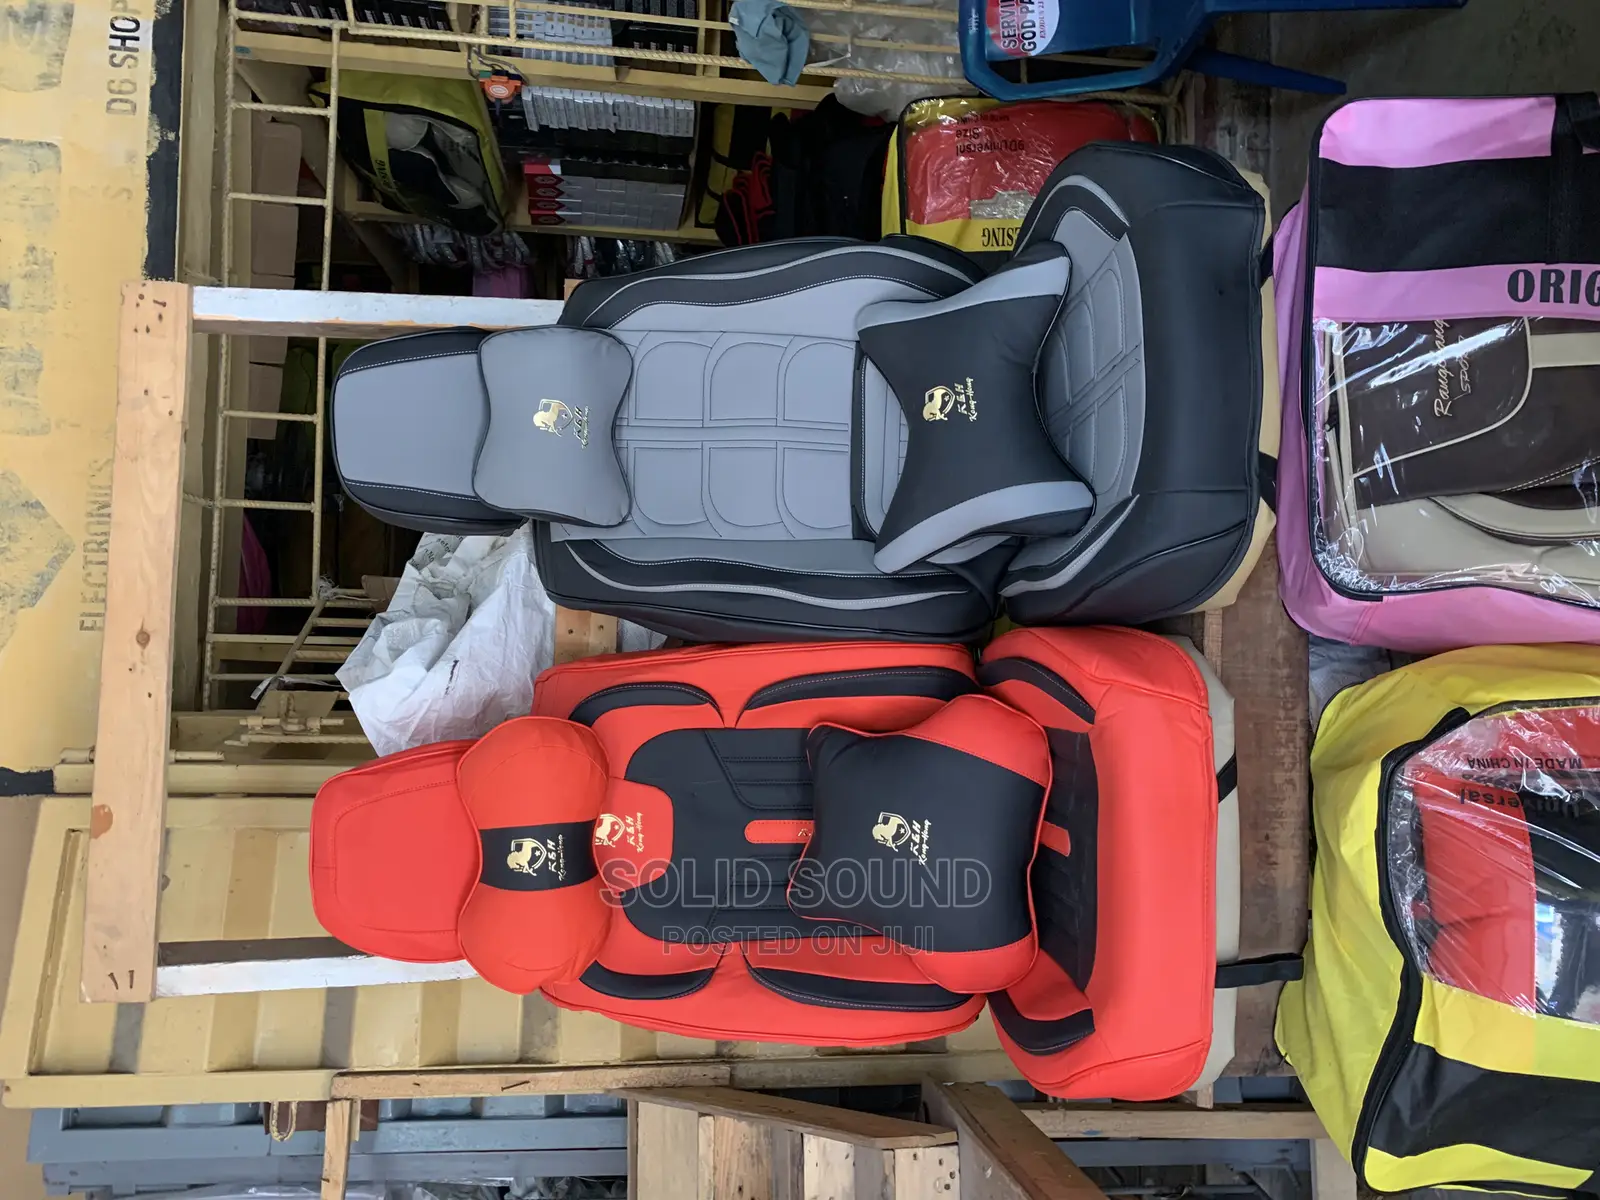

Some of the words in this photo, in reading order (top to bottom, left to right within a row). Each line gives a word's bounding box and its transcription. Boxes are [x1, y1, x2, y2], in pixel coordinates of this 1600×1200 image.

[1001, 0, 1017, 49] SERVI
[1020, 19, 1037, 52] GOD
[955, 127, 980, 139] Size
[78, 458, 113, 632] ELECTRONICS
[1466, 757, 1511, 770] CHINA
[1514, 757, 1529, 769] IN
[1535, 757, 1582, 770] MADE
